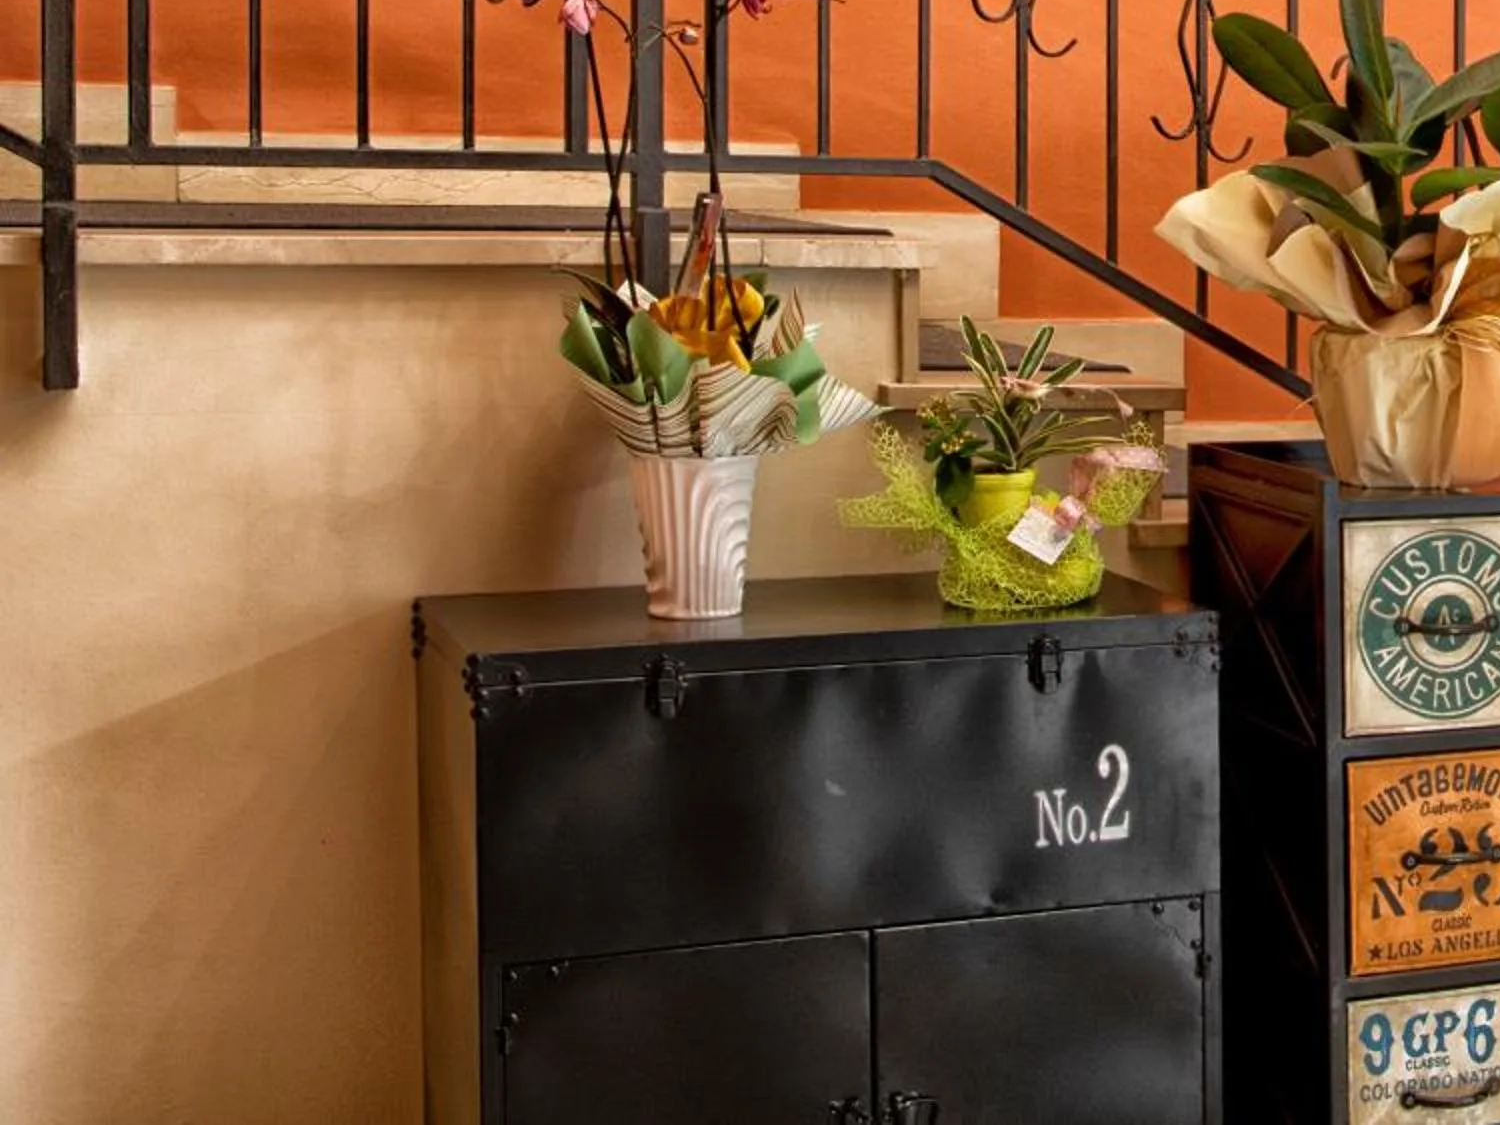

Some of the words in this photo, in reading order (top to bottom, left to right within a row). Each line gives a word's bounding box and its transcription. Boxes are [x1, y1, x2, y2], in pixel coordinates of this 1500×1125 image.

[1387, 939, 1423, 960] LOS
[1405, 1056, 1450, 1071] CLASSIC
[1360, 1076, 1452, 1102] COLORADO
